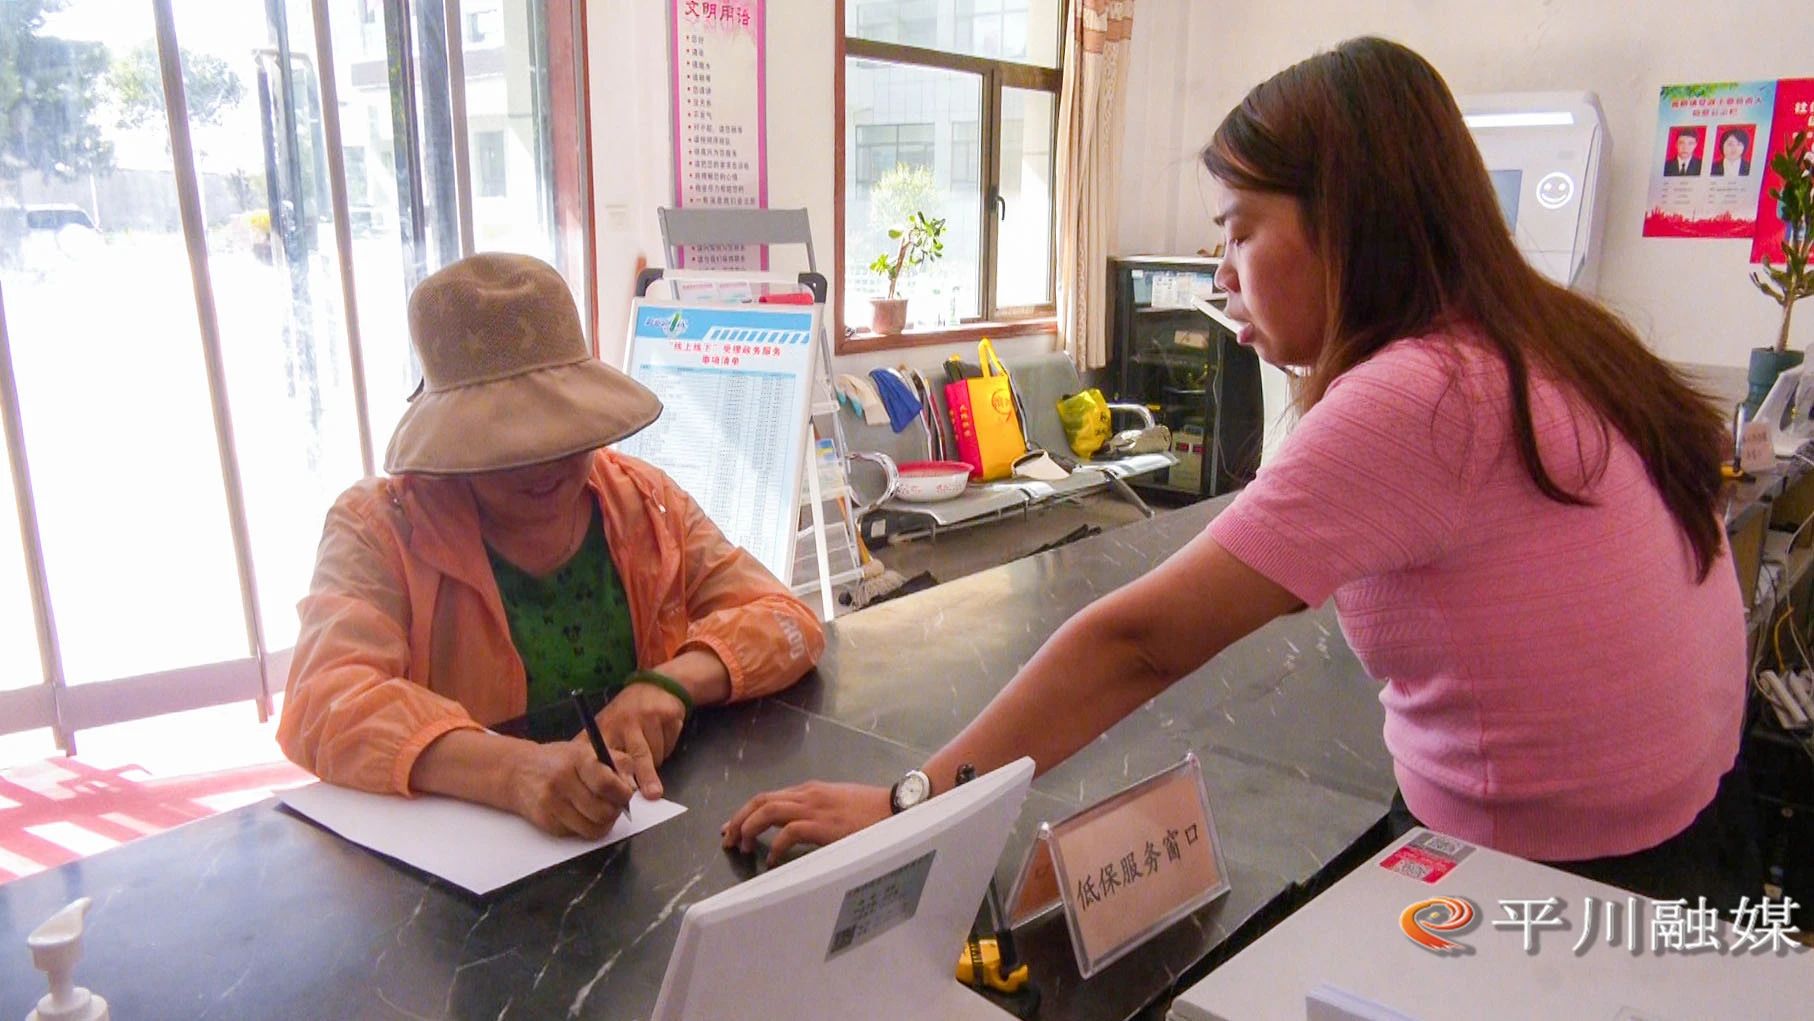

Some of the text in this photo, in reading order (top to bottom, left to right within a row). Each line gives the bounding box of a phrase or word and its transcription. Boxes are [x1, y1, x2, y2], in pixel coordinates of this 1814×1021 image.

[1076, 822, 1199, 912] 低保服务窗口
